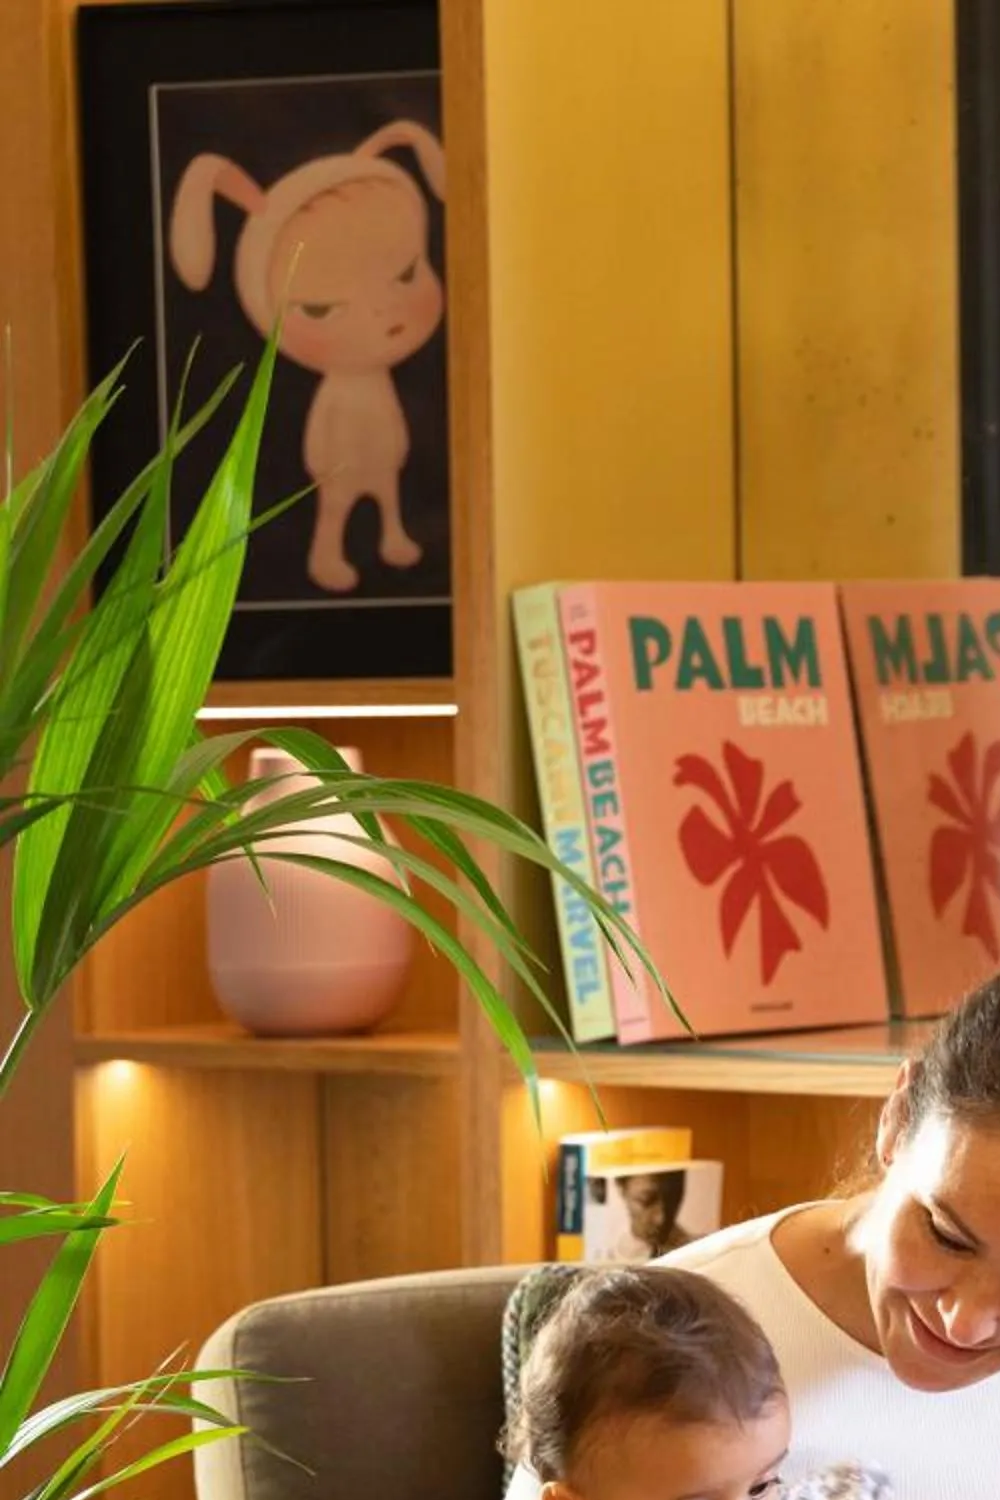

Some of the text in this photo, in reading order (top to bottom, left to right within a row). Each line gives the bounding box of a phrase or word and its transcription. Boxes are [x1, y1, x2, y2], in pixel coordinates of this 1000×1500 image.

[568, 628, 612, 756] PALM
[628, 615, 822, 690] PALM
[738, 694, 830, 727] BEACH
[586, 758, 631, 915] BEACH
[555, 827, 602, 1005] MRVEL
